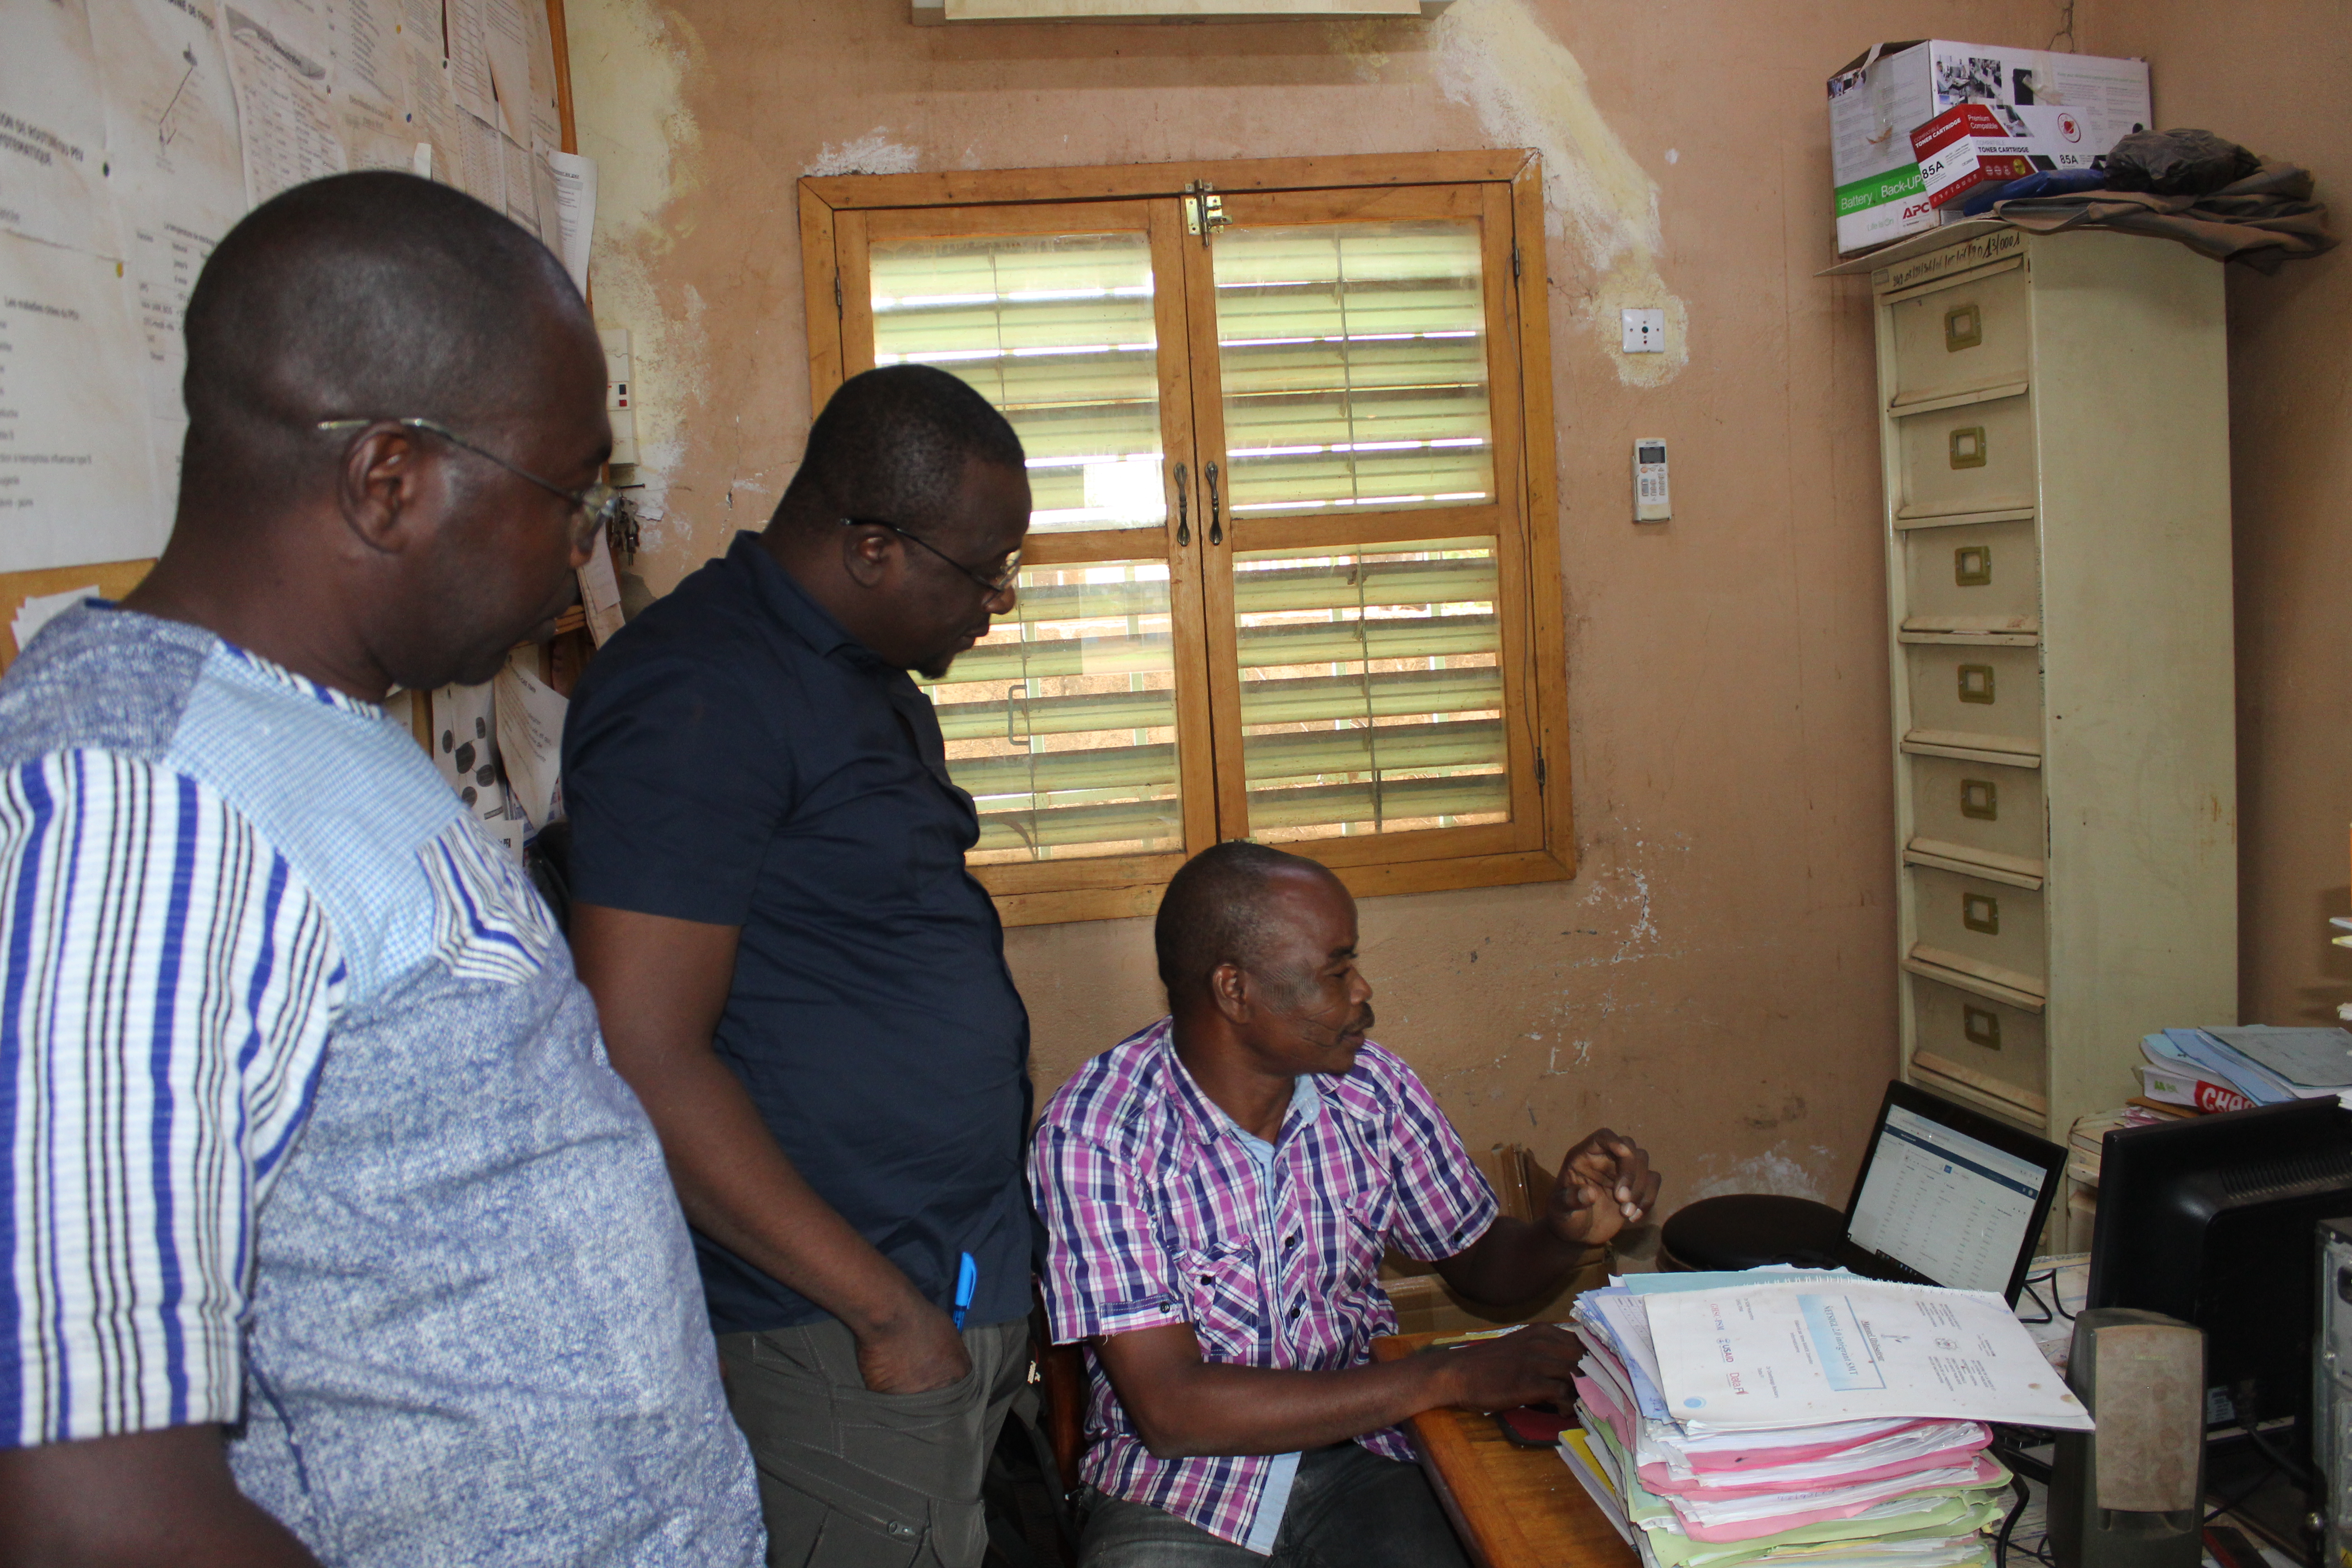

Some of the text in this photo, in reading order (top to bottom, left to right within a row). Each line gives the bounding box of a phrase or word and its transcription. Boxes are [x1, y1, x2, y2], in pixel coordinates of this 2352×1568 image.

[1915, 117, 1961, 148] TONER CARTRIDGE
[1970, 121, 1998, 129] Compatible
[1922, 161, 1945, 179] 85A
[2059, 154, 2078, 164] 85A
[1841, 192, 1872, 210] Battery
[1881, 174, 1925, 198] Back-UP
[1902, 202, 1930, 220] APC
[1710, 1303, 1725, 1331] GHSC-PSM
[1823, 1305, 1858, 1376] NETSIGL 2.0 intégrant SMT
[1862, 1321, 1885, 1362] Manuel Utilisateur
[1722, 1344, 1734, 1363] USAID
